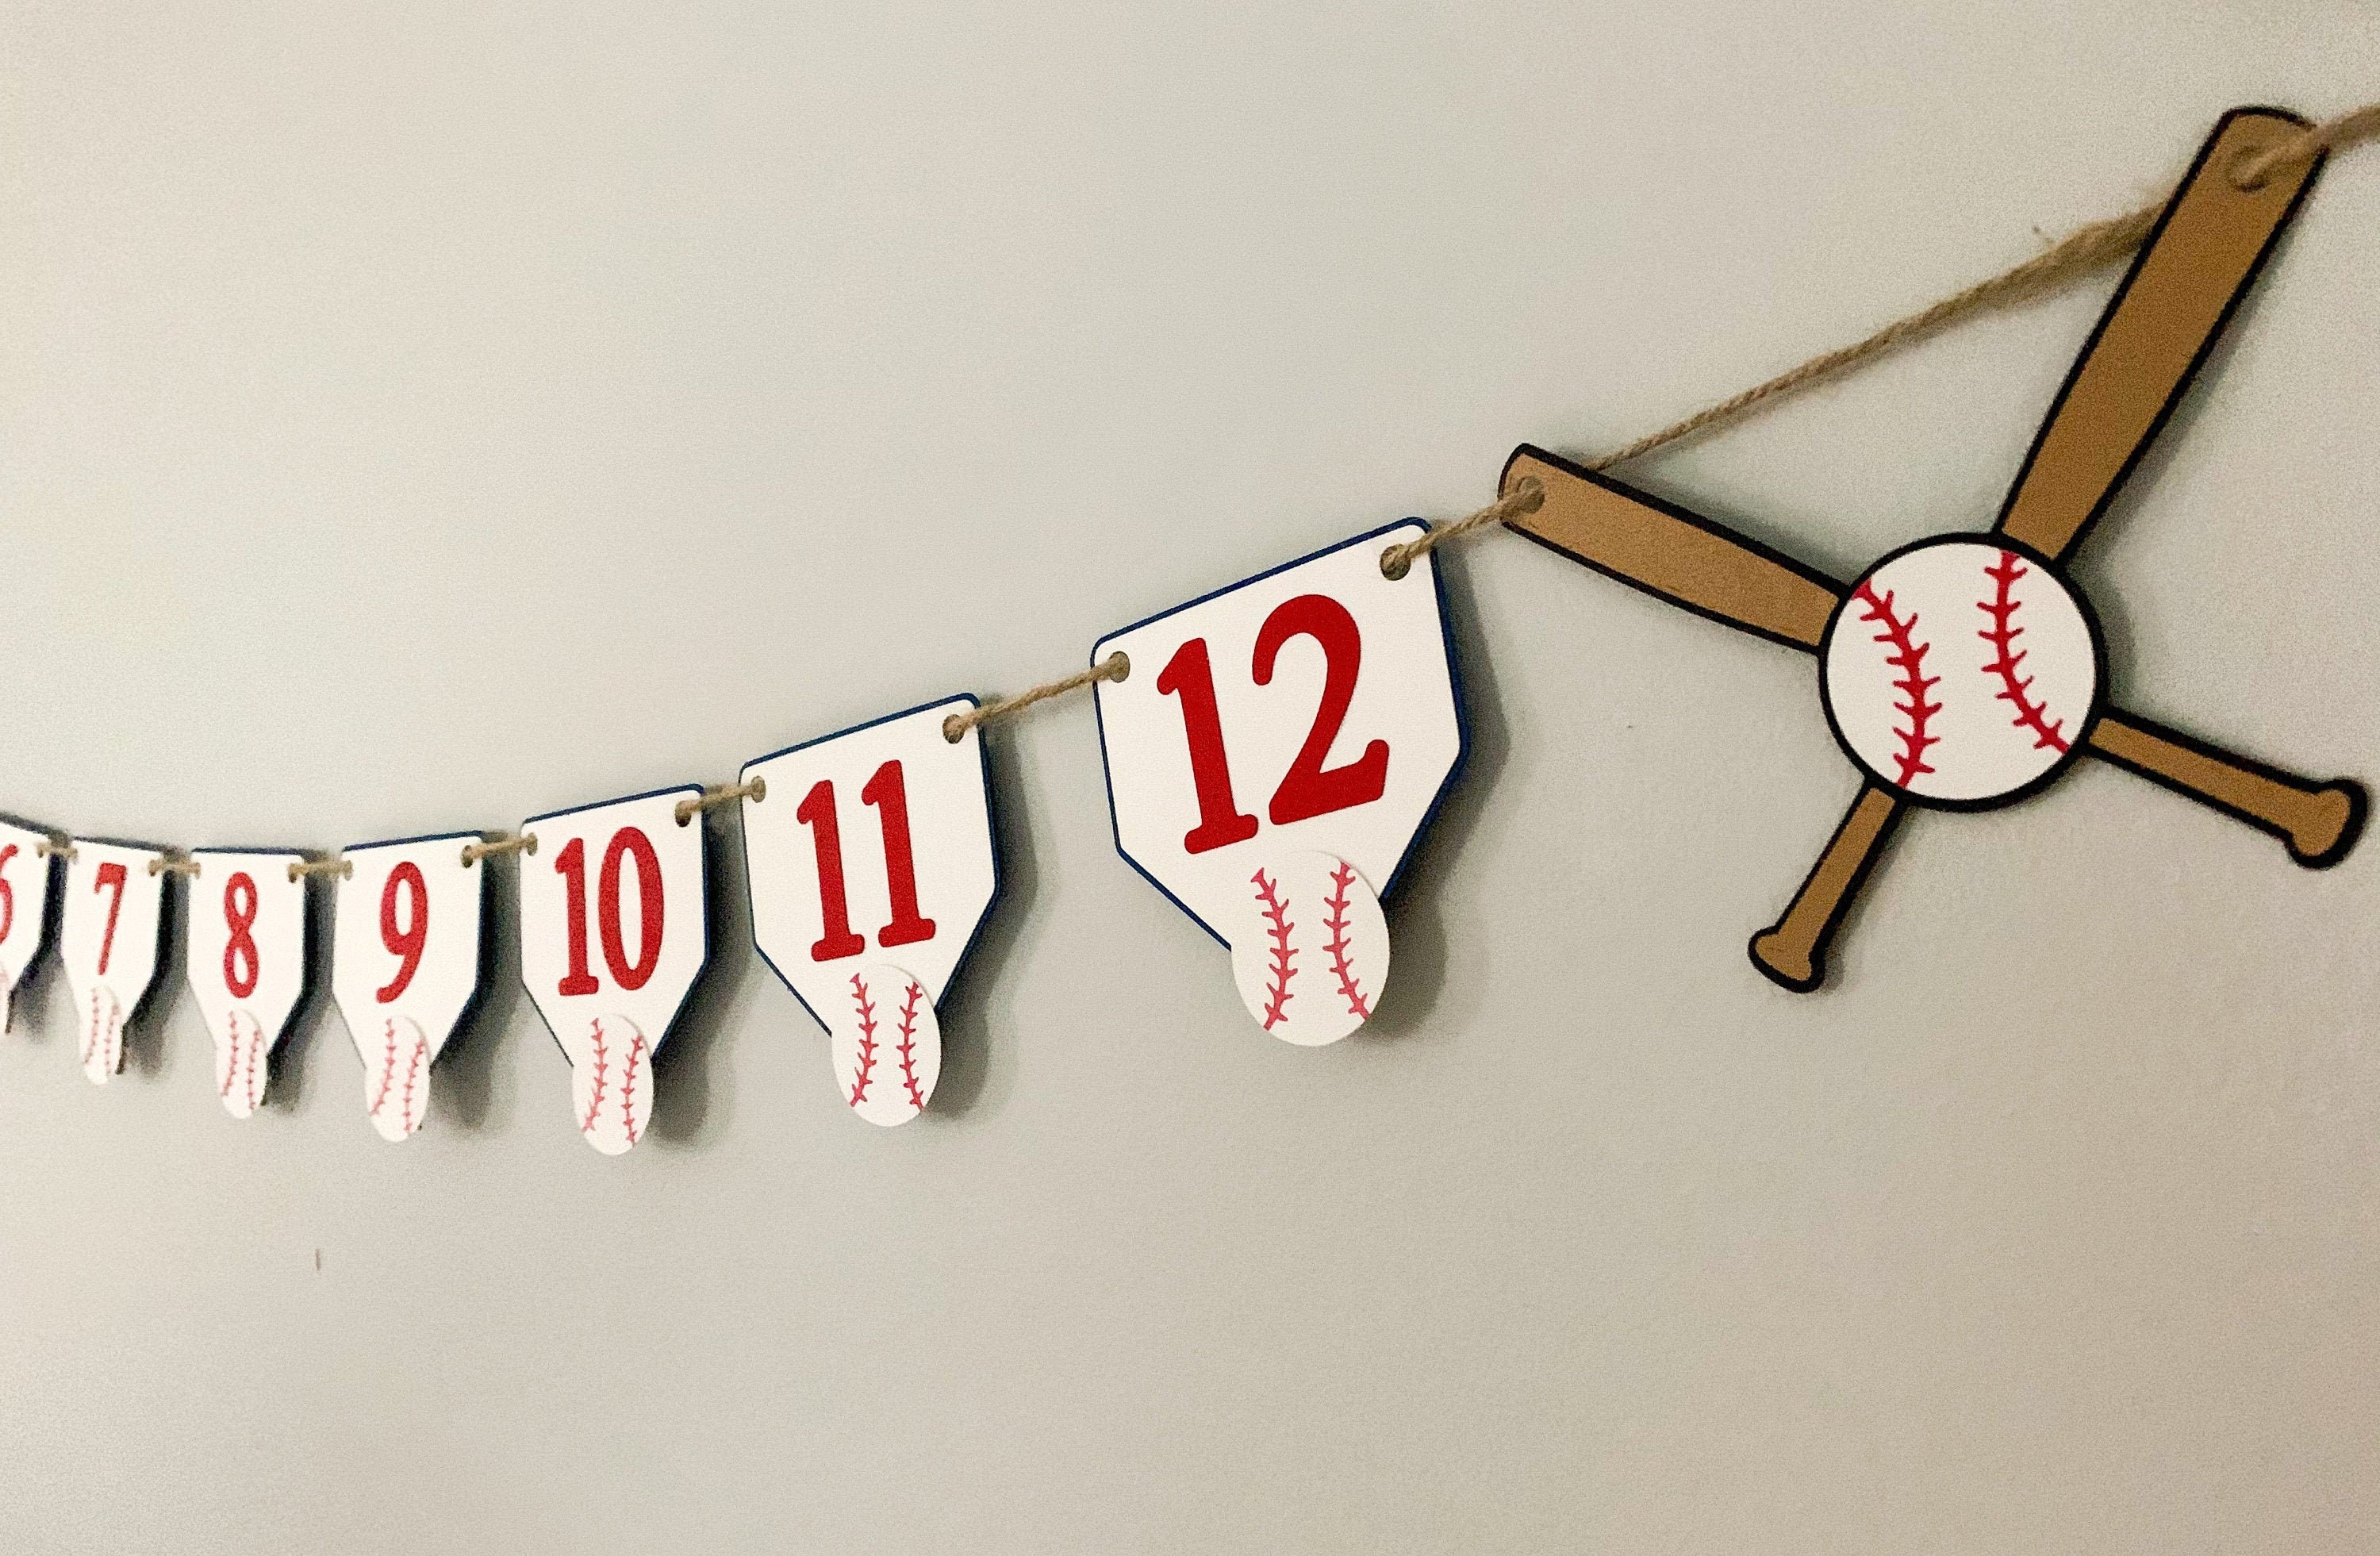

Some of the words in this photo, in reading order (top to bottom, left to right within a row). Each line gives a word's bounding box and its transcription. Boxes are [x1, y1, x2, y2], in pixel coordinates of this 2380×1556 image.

[1156, 594, 1390, 855] 12
[94, 862, 127, 975] 7
[223, 871, 259, 999] 8
[375, 861, 429, 1004] 9
[554, 826, 665, 997] 10
[796, 759, 936, 962] 11
